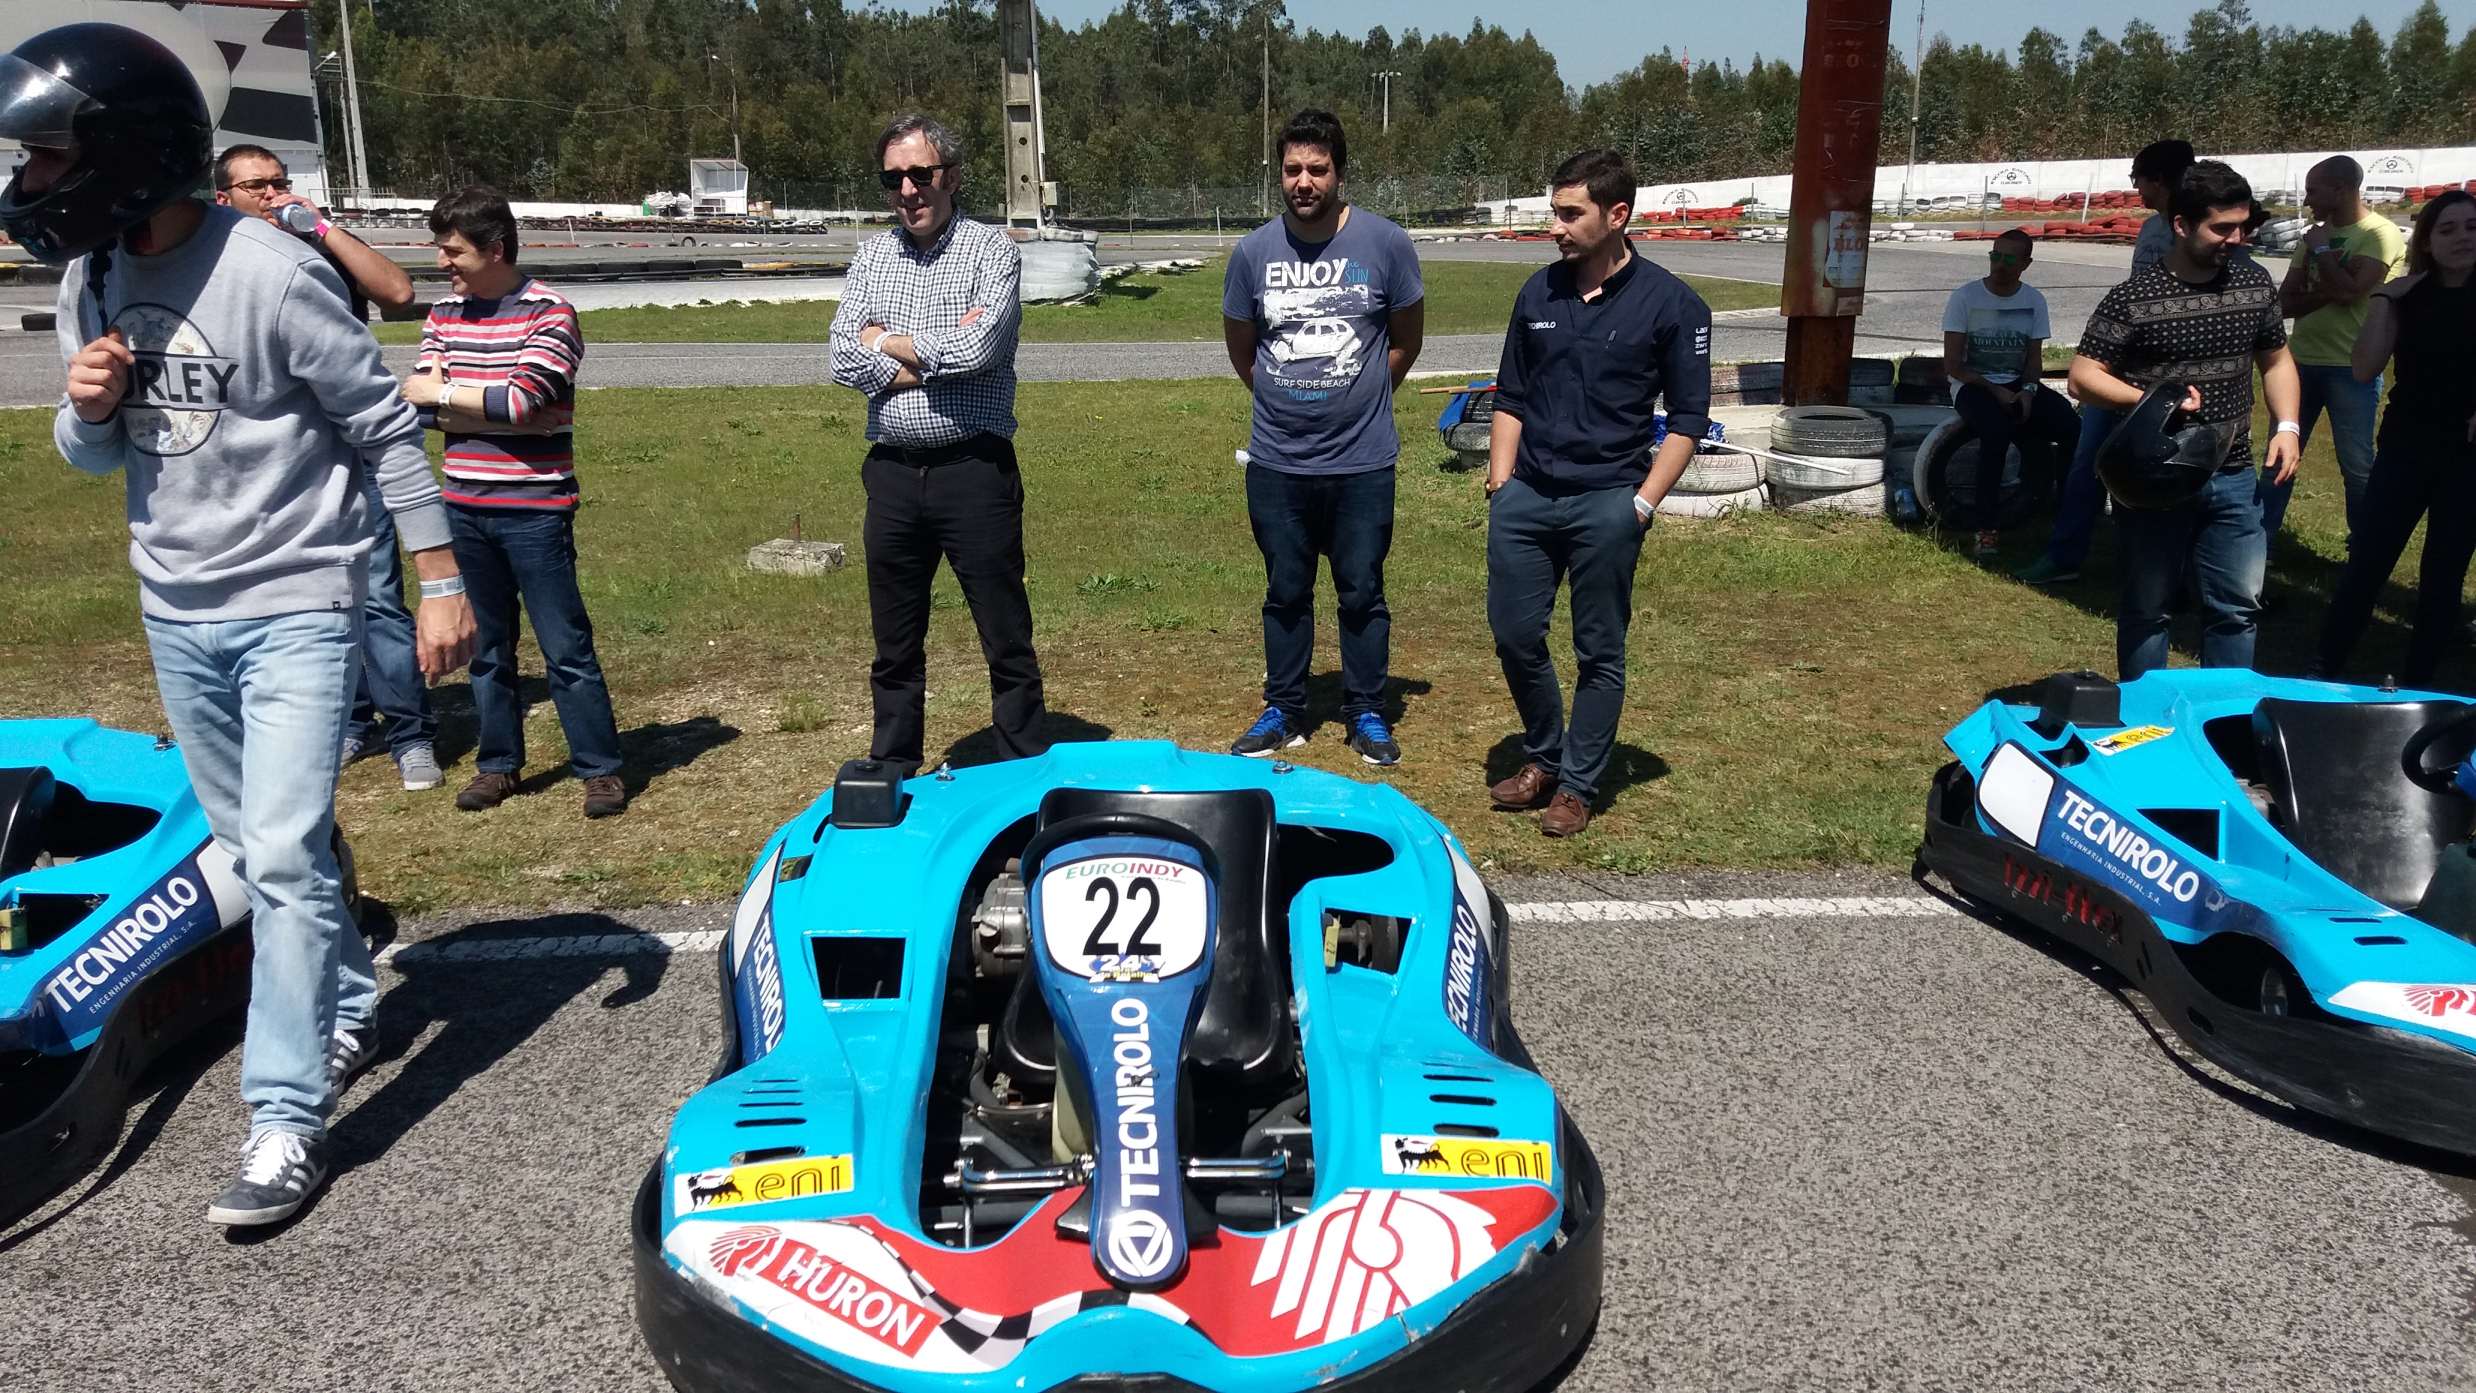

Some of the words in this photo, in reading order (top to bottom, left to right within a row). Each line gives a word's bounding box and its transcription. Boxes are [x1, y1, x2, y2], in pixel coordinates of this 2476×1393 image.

[1265, 258, 1349, 288] ENJOY
[1274, 377, 1295, 387] SURF
[1289, 388, 1329, 401] MIAMI
[2057, 789, 2200, 903] TECNIROLO
[2060, 831, 2103, 865] ENGENHARIA
[1065, 862, 1184, 881] EUROINDY
[1082, 876, 1162, 956] 22
[44, 876, 198, 1013] TECNIROLO
[753, 912, 784, 1054] TECNIROL
[1447, 904, 1477, 1032] ECNIROLO
[88, 969, 139, 1015] ENGENHARIA
[1111, 997, 1160, 1208] TECNIROLO
[754, 1155, 841, 1201] eni
[1460, 1141, 1545, 1181] eni
[776, 1247, 926, 1347] HURON
